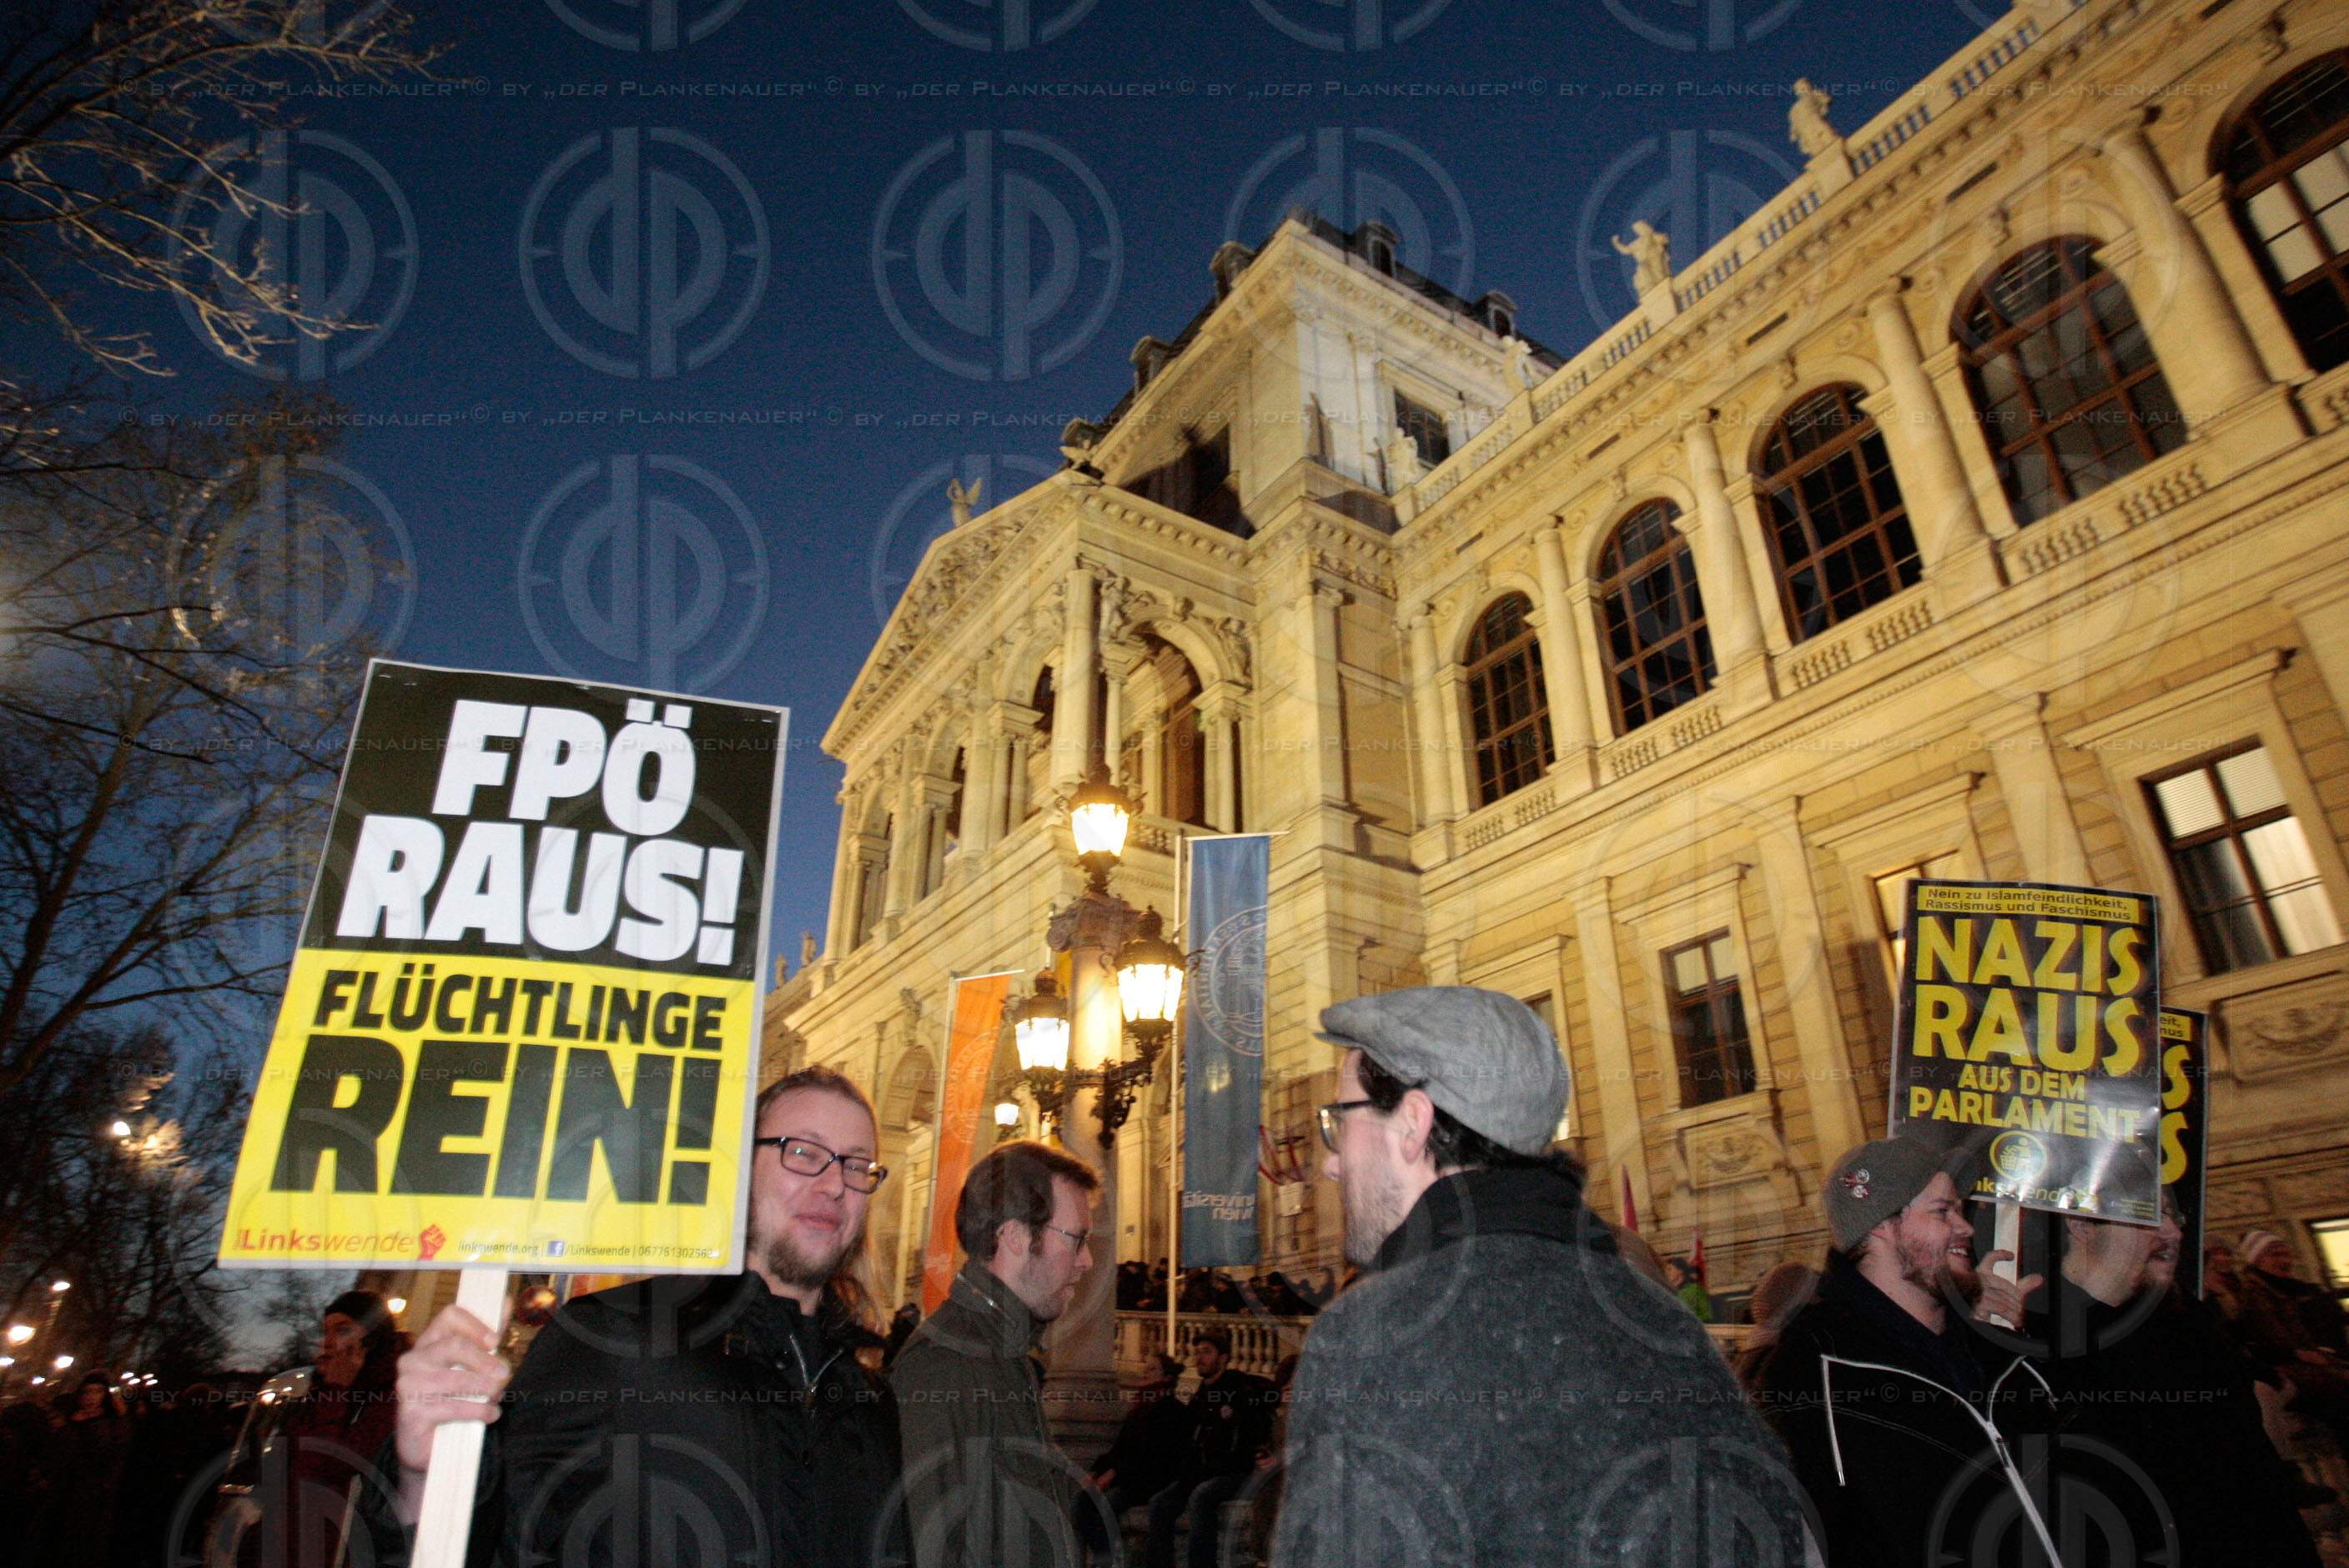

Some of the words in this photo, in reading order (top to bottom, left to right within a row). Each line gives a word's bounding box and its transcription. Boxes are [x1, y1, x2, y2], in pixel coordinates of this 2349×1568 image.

[431, 698, 696, 835] FPÖ
[336, 814, 744, 966] RAUS!
[1925, 899, 2002, 912] Rassismus
[2007, 902, 2035, 912] und
[2040, 903, 2131, 921] Faschismus
[1928, 888, 1960, 899] Nein
[1965, 892, 1982, 900] zu
[1916, 916, 2140, 996] NAZIS
[312, 962, 727, 1053] FLÜCHTLINGE
[1913, 984, 2140, 1078] RAUS
[269, 1034, 723, 1207] REIN!
[1909, 1087, 2141, 1143] PARLAMENT
[1958, 1063, 2014, 1094] AUS
[2020, 1071, 2088, 1102] DEM
[242, 1229, 415, 1253] Linkswende
